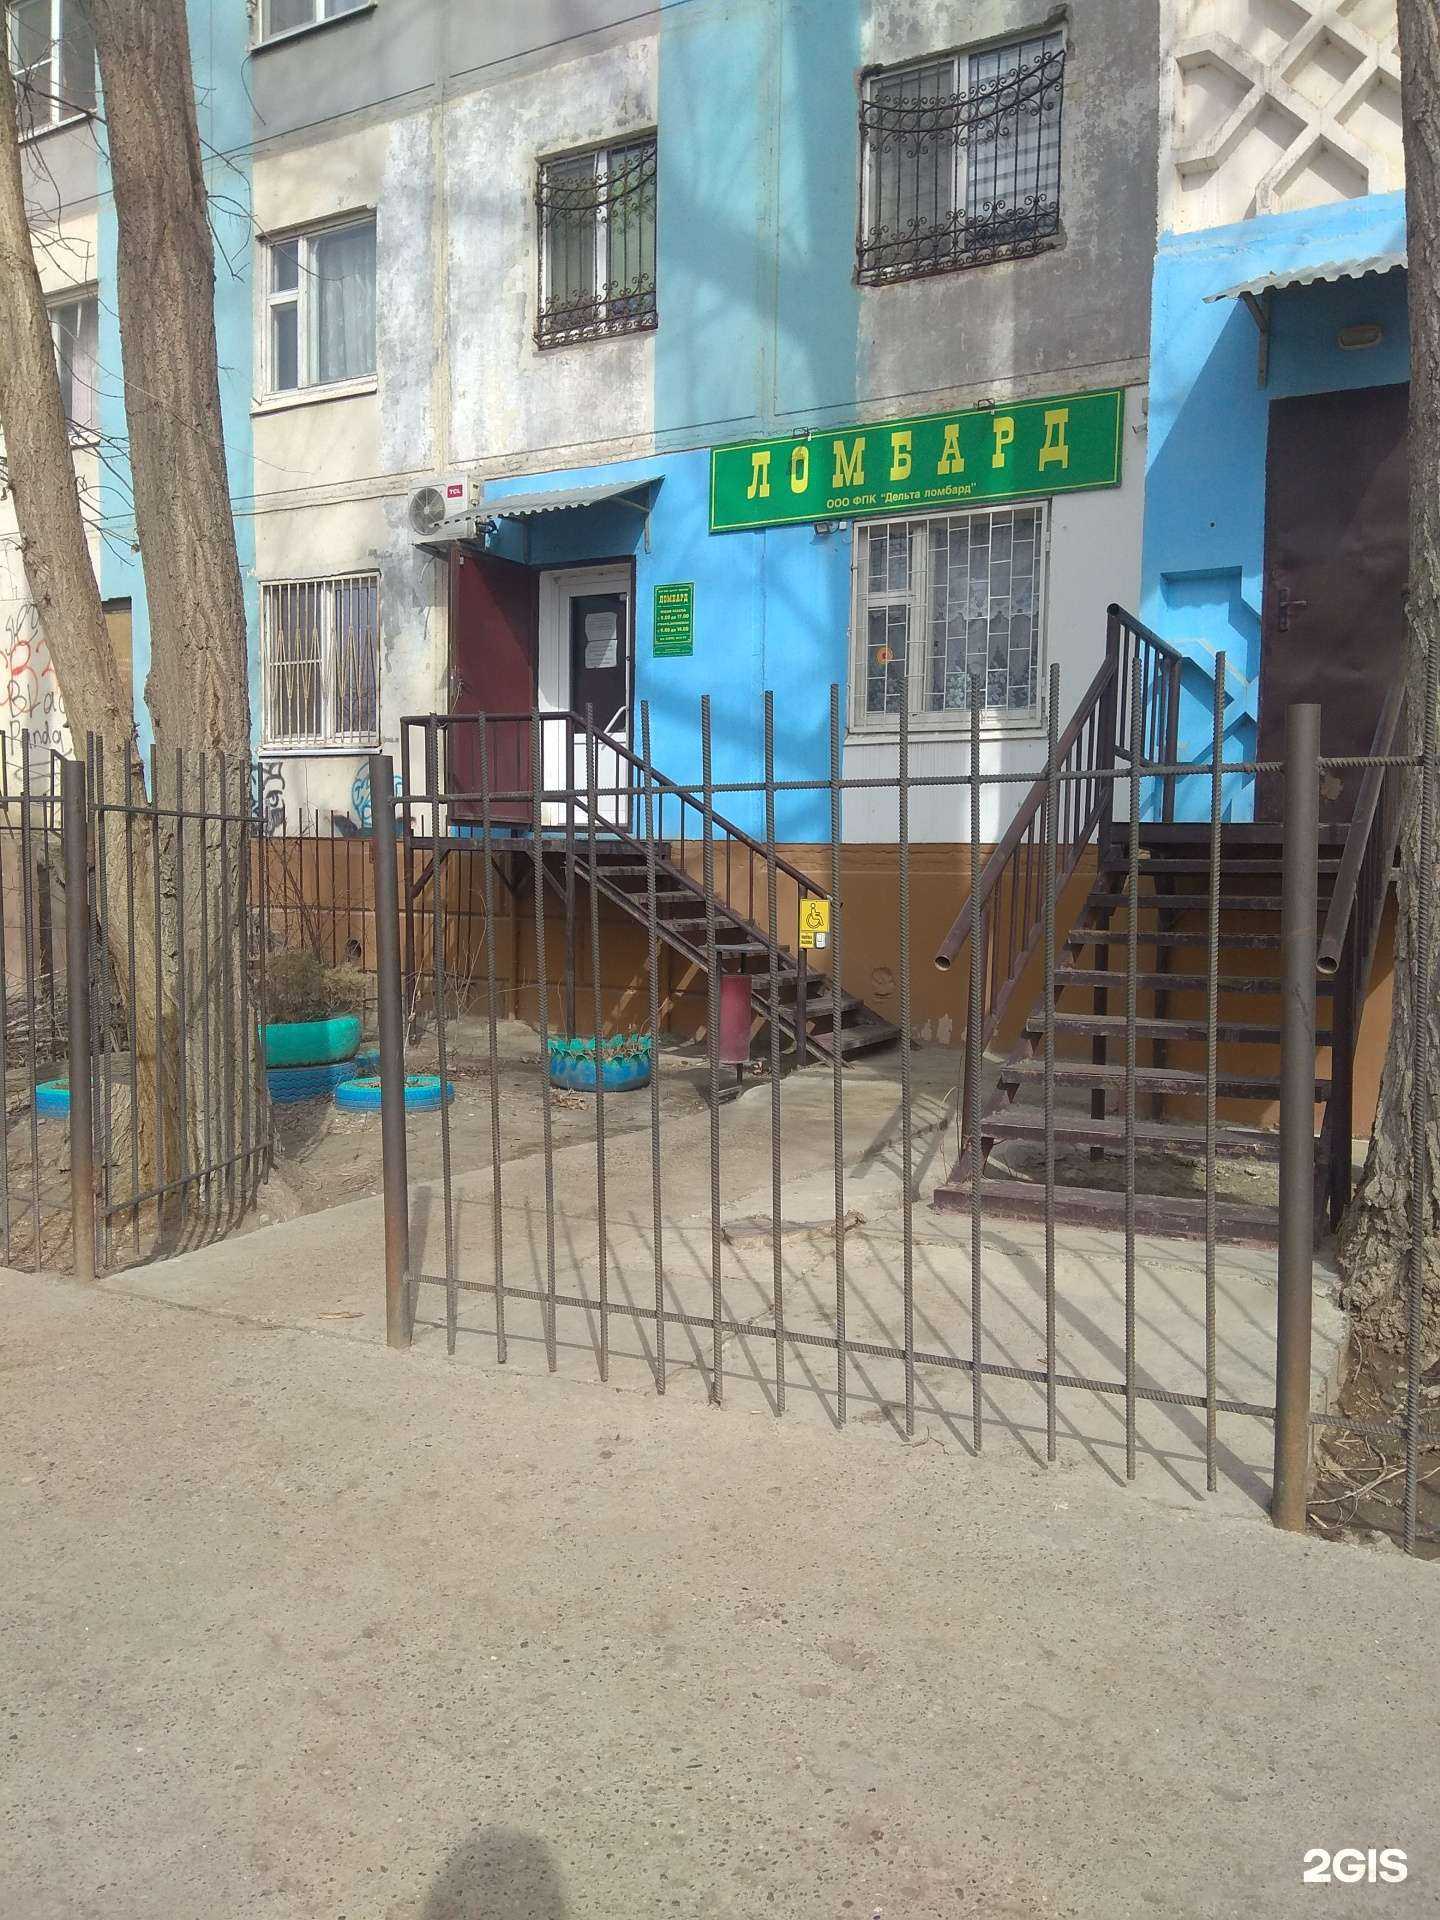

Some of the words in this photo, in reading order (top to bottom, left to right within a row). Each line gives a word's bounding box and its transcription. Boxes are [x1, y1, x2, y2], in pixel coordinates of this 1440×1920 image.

[747, 408, 1069, 500] ЛОМБАРД
[826, 497, 850, 509] ООО
[852, 494, 877, 505] ФПК
[659, 594, 688, 603] ЛОМБАРД
